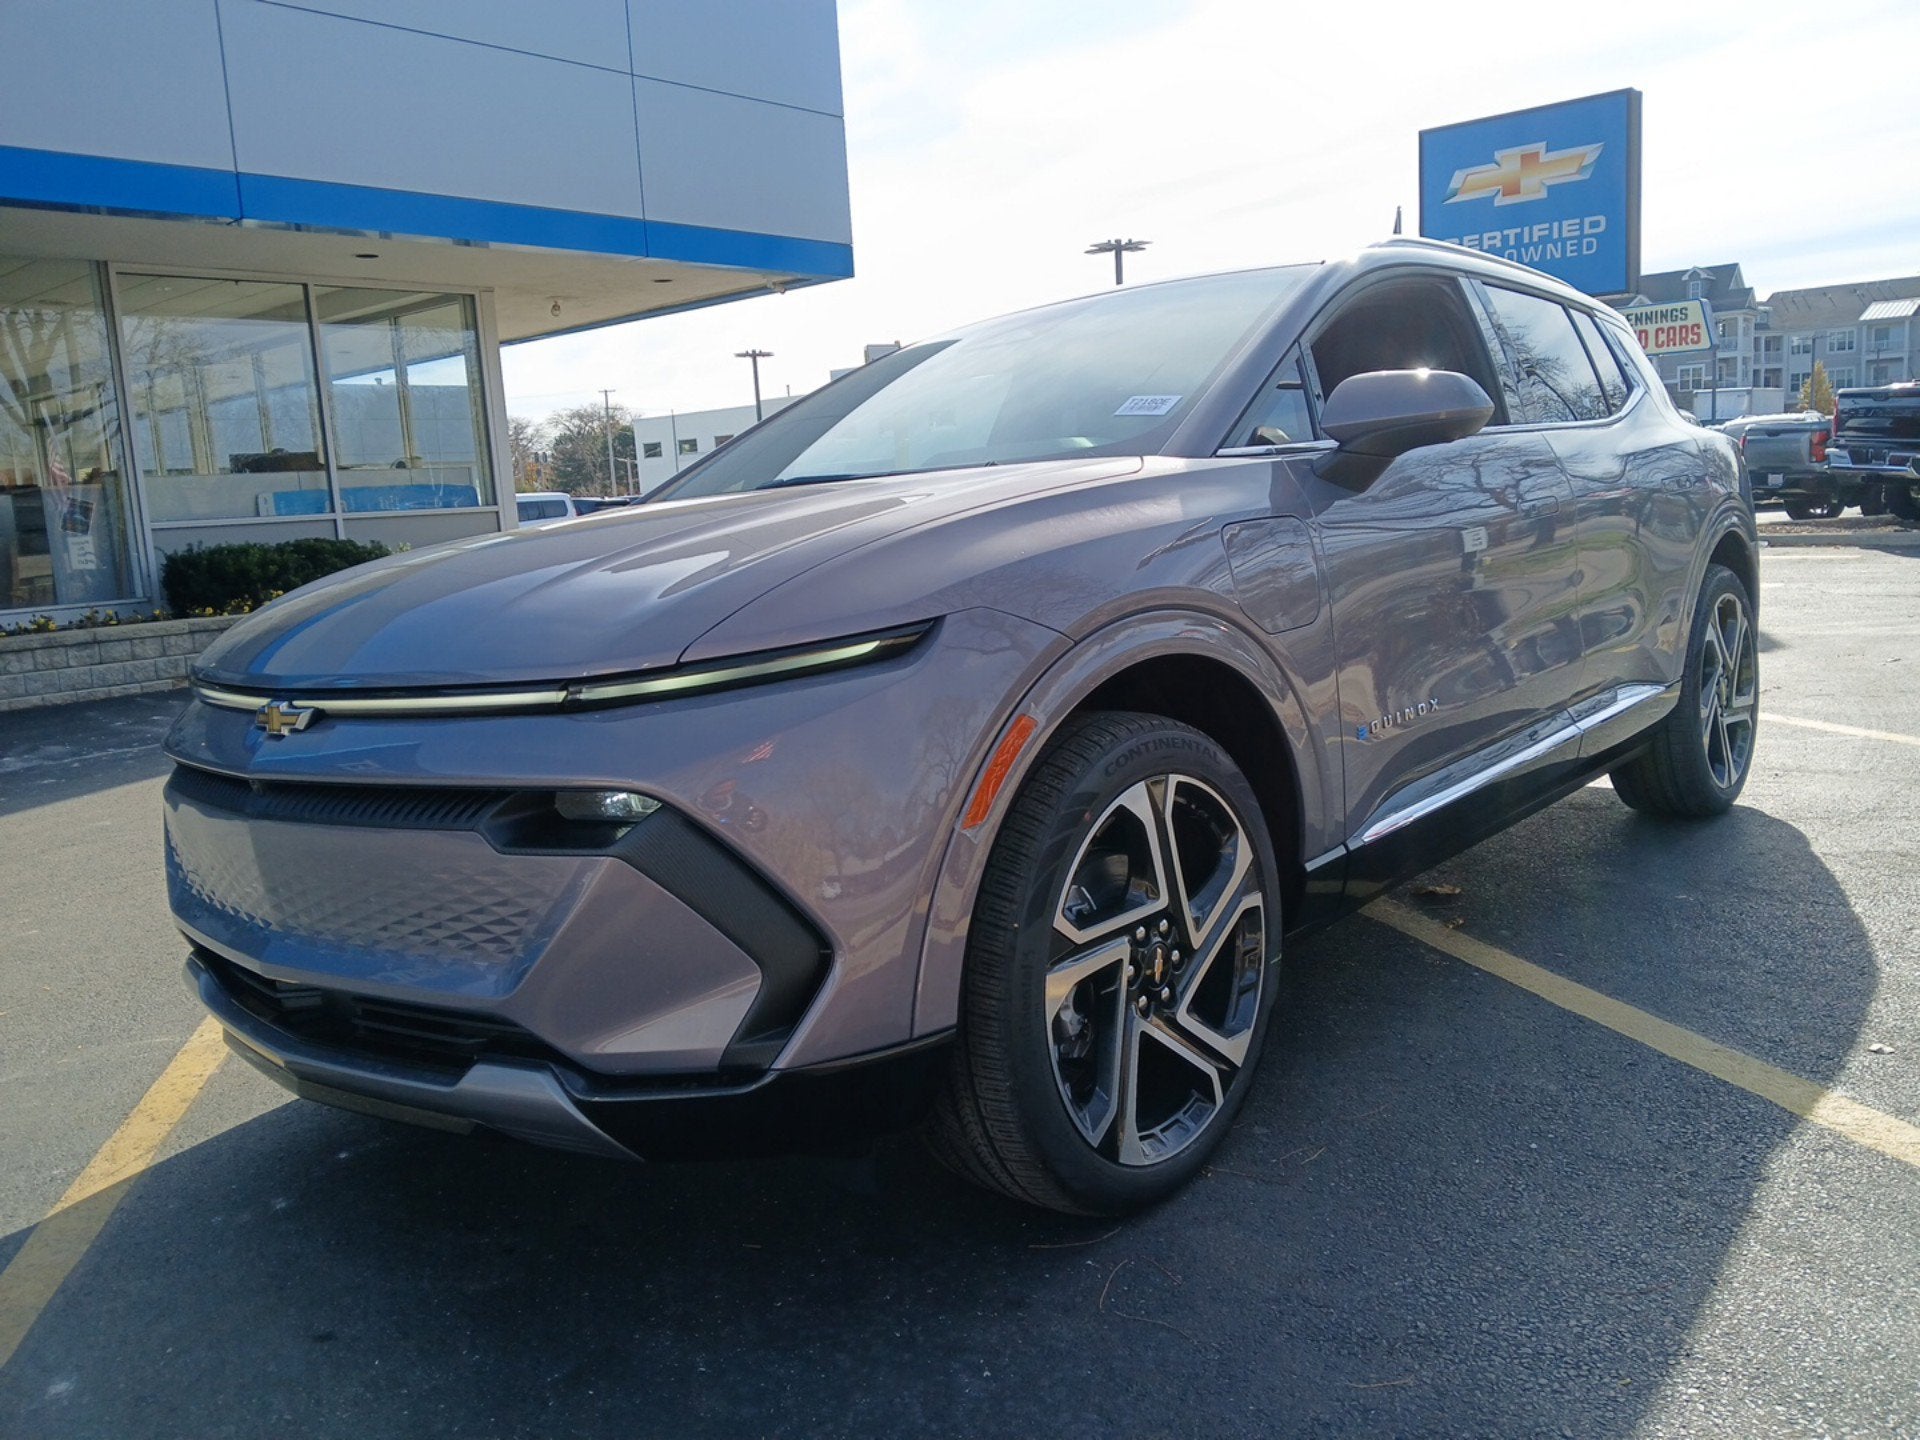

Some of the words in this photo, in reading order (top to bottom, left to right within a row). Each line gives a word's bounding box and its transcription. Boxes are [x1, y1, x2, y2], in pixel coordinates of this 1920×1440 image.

[1504, 237, 1598, 264] OWNED
[1624, 307, 1689, 327] ENNINGS
[1655, 323, 1702, 349] CARS
[1356, 697, 1440, 741] EQUINOX
[1103, 736, 1223, 778] CONTINENTAL
